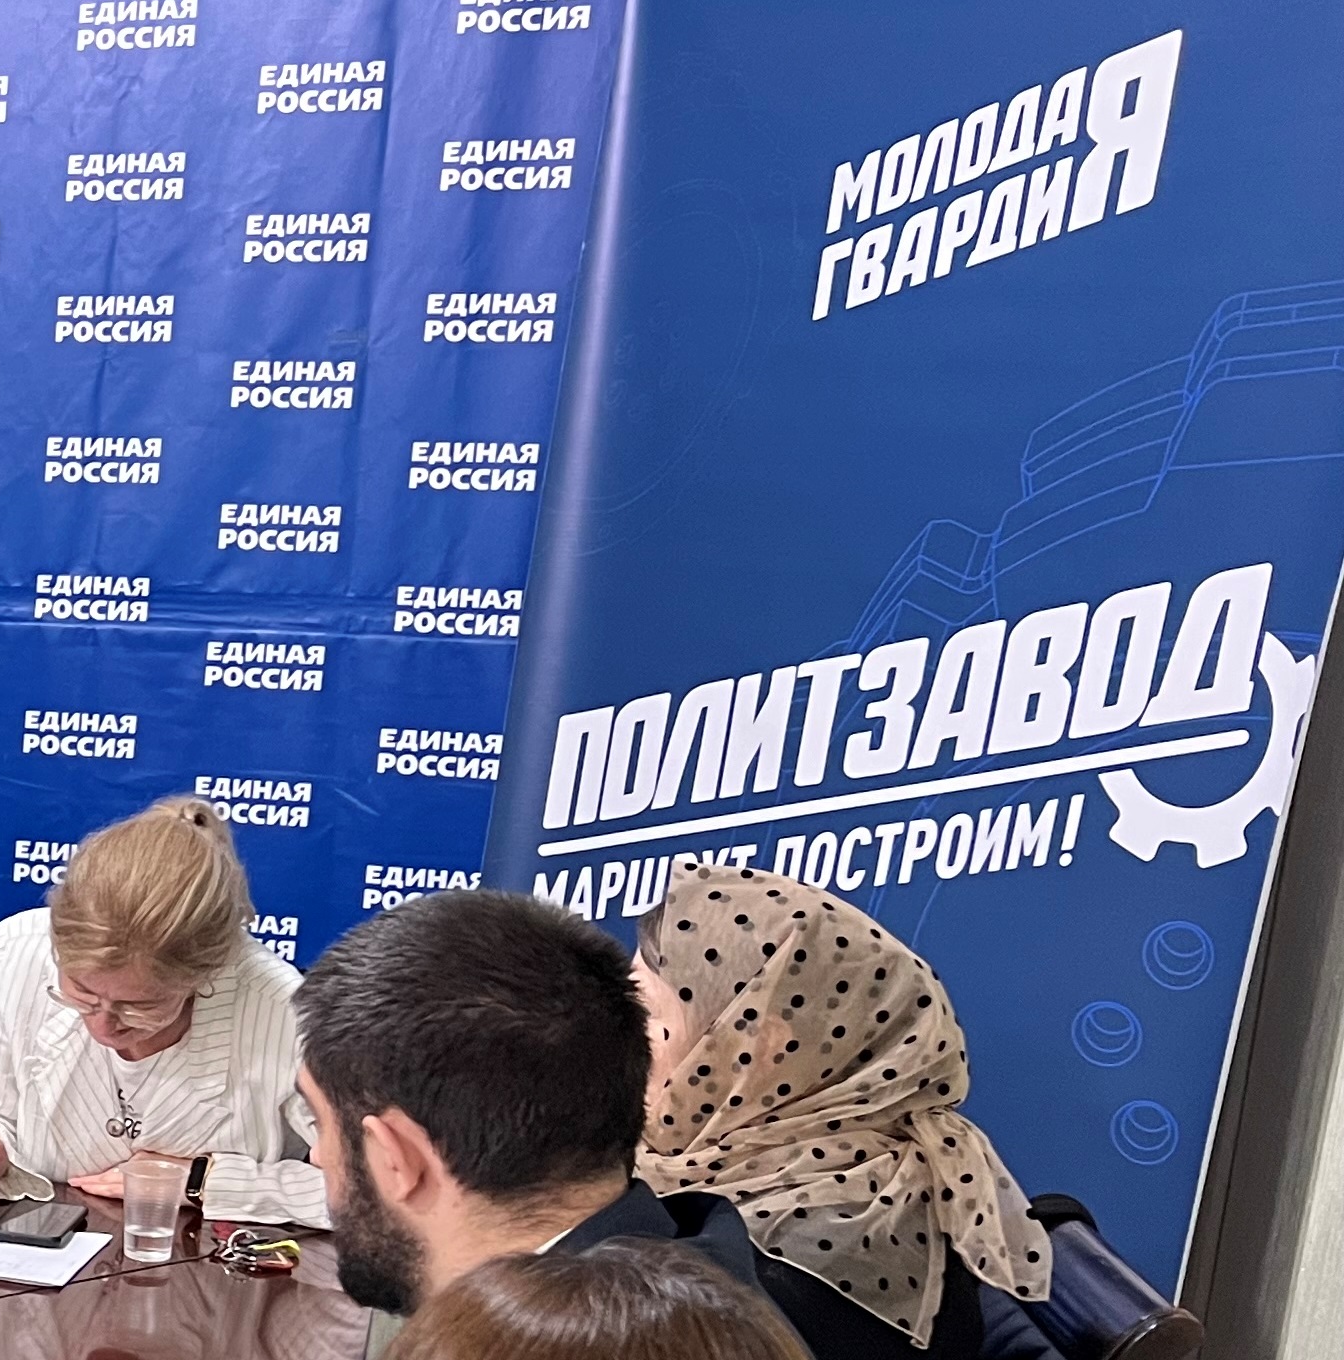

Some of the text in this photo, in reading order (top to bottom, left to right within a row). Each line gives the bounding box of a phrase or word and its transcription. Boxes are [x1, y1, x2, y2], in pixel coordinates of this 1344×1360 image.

[78, 0, 199, 26] ЕДИНАЯ
[456, 4, 592, 35] РОССИЯ
[76, 24, 197, 52] РОССИЯ
[259, 60, 386, 89] ЕДИНАЯ
[256, 87, 383, 115] РОССИЯ
[825, 29, 1183, 234] МОЛОДАЯ
[442, 137, 576, 166] ЕДИНАЯ
[67, 151, 186, 178] ЕДИНАЯ
[65, 177, 184, 202] РОССИЯ
[439, 165, 573, 192] РОССИЯ
[245, 213, 371, 238] ЕДИНАЯ
[243, 239, 368, 263] РОССИЯ
[57, 295, 175, 319] ЕДИНАЯ
[426, 292, 557, 317] ЕДИНАЯ
[55, 320, 173, 343] РОССИЯ
[423, 319, 554, 343] РОССИЯ
[232, 360, 356, 384] ЕДИНАЯ
[230, 386, 354, 409] РОССИЯ
[46, 437, 162, 460] ЕДИНАЯ
[411, 441, 540, 466] ЕДИНАЯ
[44, 461, 160, 484] РОССИЯ
[408, 467, 537, 492] РОССИЯ
[220, 503, 342, 527] ЕДИНАЯ
[218, 528, 339, 553] РОССИЯ
[36, 574, 150, 597] ЕДИНАЯ
[396, 586, 523, 610] ЕДИНАЯ
[34, 598, 149, 622] РОССИЯ
[393, 610, 520, 637] РОССИЯ
[206, 641, 326, 665] ЕДИНАЯ
[204, 665, 323, 691] РОССИЯ
[541, 562, 1273, 830] ПОЛИТЗАВОД
[24, 710, 137, 734] ЕДИНАЯ
[22, 733, 135, 759] РОССИЯ
[379, 728, 504, 755] ЕДИНАЯ
[376, 752, 500, 781] РОССИЯ
[195, 776, 312, 802] ЕДИНАЯ
[211, 801, 310, 828] ОССИЯ
[531, 793, 1085, 922] МАРШ ПОСТРОИМ!
